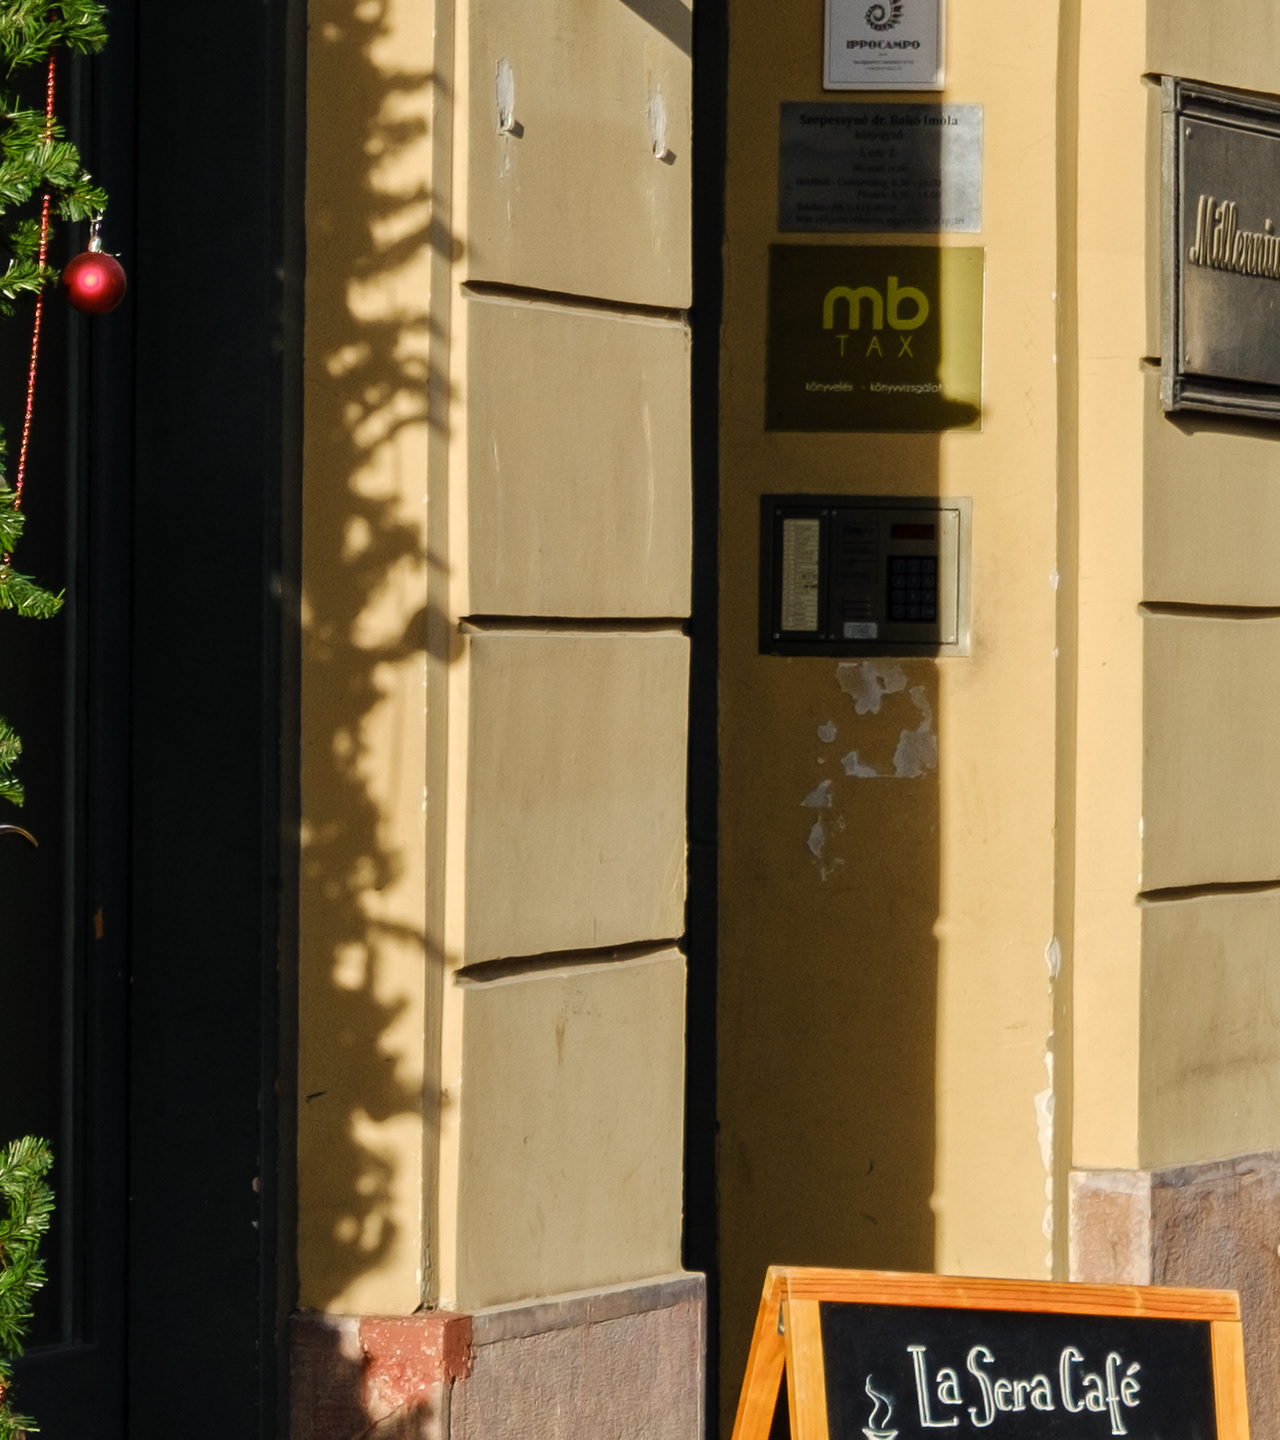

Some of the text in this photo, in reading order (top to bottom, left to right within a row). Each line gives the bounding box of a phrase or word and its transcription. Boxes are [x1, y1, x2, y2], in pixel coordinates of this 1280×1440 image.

[846, 39, 921, 50] IPPOCAMPO
[799, 113, 869, 128] Szepessyné
[870, 113, 889, 126] dr.
[822, 275, 930, 331] mb
[836, 334, 914, 358] TAX
[906, 1343, 1141, 1435] La Sera Café
